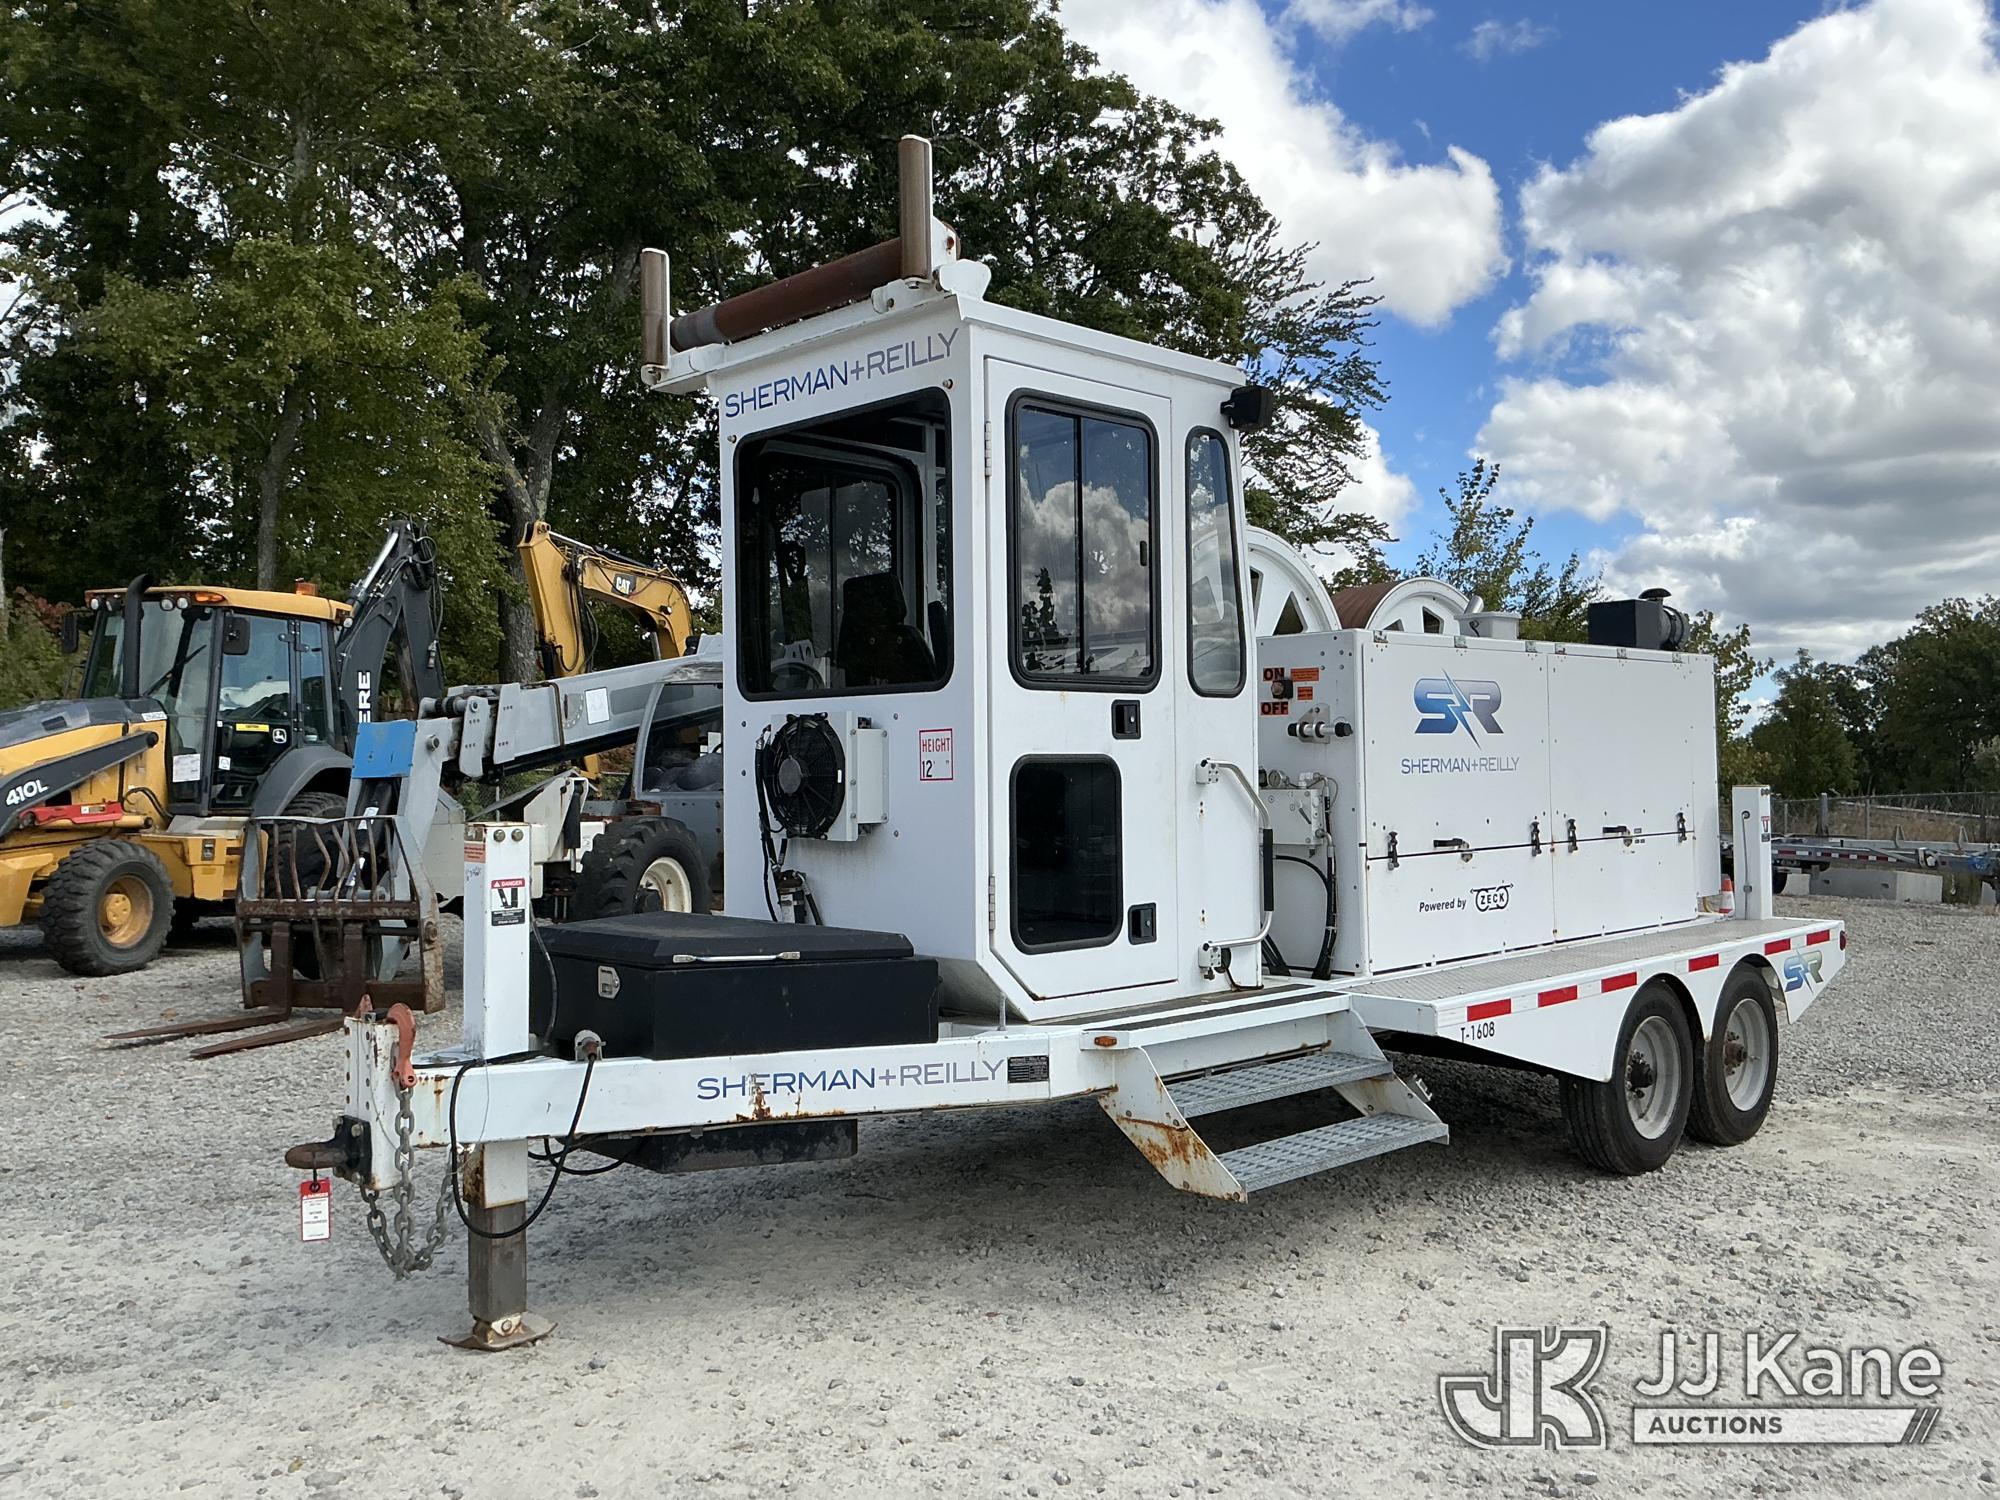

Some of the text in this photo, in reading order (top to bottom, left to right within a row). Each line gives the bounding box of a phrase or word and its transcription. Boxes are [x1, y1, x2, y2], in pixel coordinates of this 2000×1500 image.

[725, 328, 959, 418] SHERMAN+REILLY
[616, 576, 631, 595] CAT
[1263, 668, 1284, 681] ON
[1261, 702, 1288, 715] OFF
[922, 738, 950, 752] HEIGHT
[1401, 757, 1520, 775] SHERMAN+REILLY
[6, 780, 49, 805] 410L
[1419, 892, 1505, 912] Powered by ZECK
[1461, 1021, 1495, 1042] T-1608
[697, 1059, 1005, 1100] SHERMAN+REILLY
